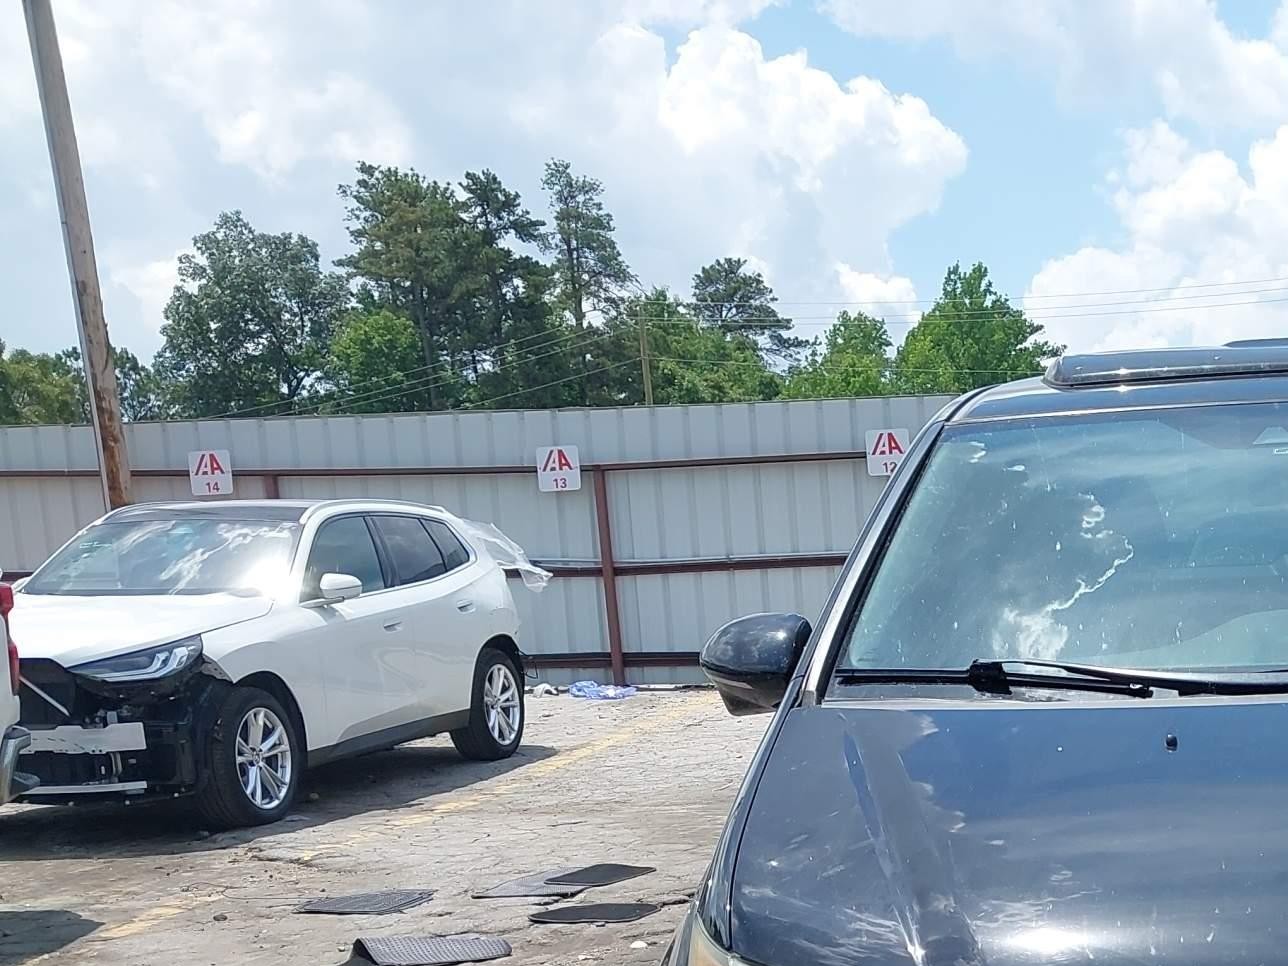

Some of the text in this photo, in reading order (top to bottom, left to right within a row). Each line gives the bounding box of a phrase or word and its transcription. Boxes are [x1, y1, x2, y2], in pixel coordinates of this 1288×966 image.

[882, 461, 898, 473] 12
[205, 481, 220, 493] 14
[553, 478, 567, 489] 13
